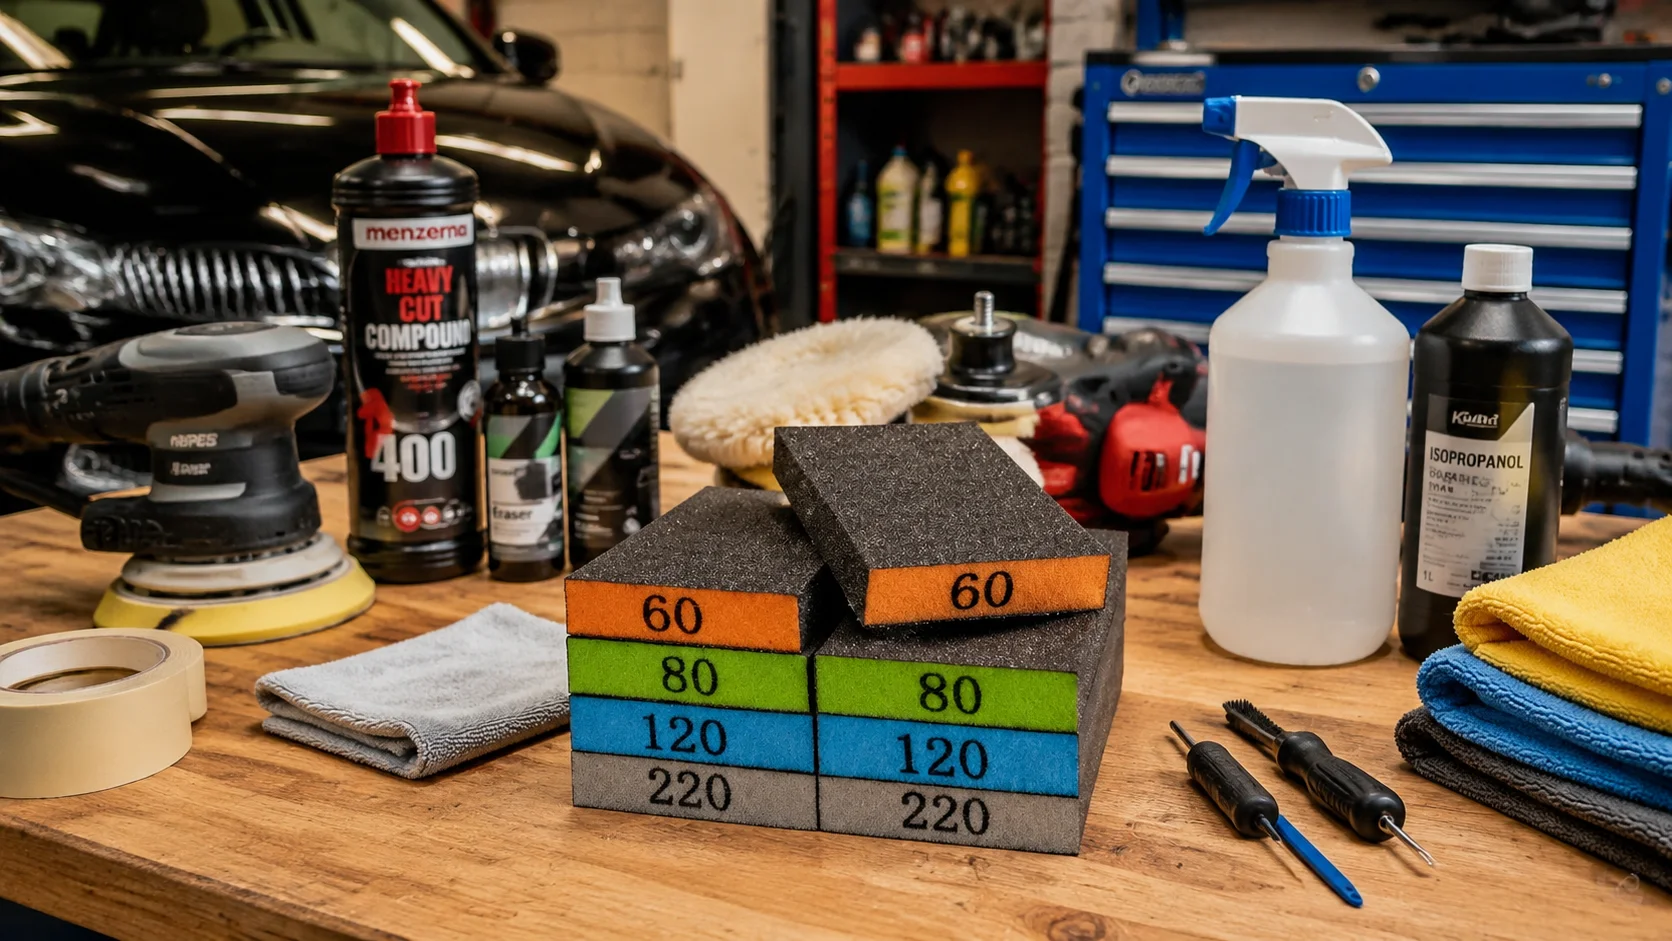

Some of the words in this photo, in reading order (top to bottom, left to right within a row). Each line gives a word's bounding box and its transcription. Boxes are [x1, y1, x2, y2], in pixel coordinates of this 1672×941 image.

[385, 265, 454, 294] HEAVY
[399, 295, 444, 322] CUT
[371, 431, 457, 483] 400
[1430, 446, 1524, 469] ISOPROPANOL
[951, 570, 1014, 610] 60
[642, 594, 703, 635] 60
[661, 656, 719, 697] 80
[919, 672, 983, 715] 80
[642, 713, 728, 756] 120
[897, 733, 989, 780] 120
[648, 766, 732, 812] 220
[901, 791, 991, 836] 220
